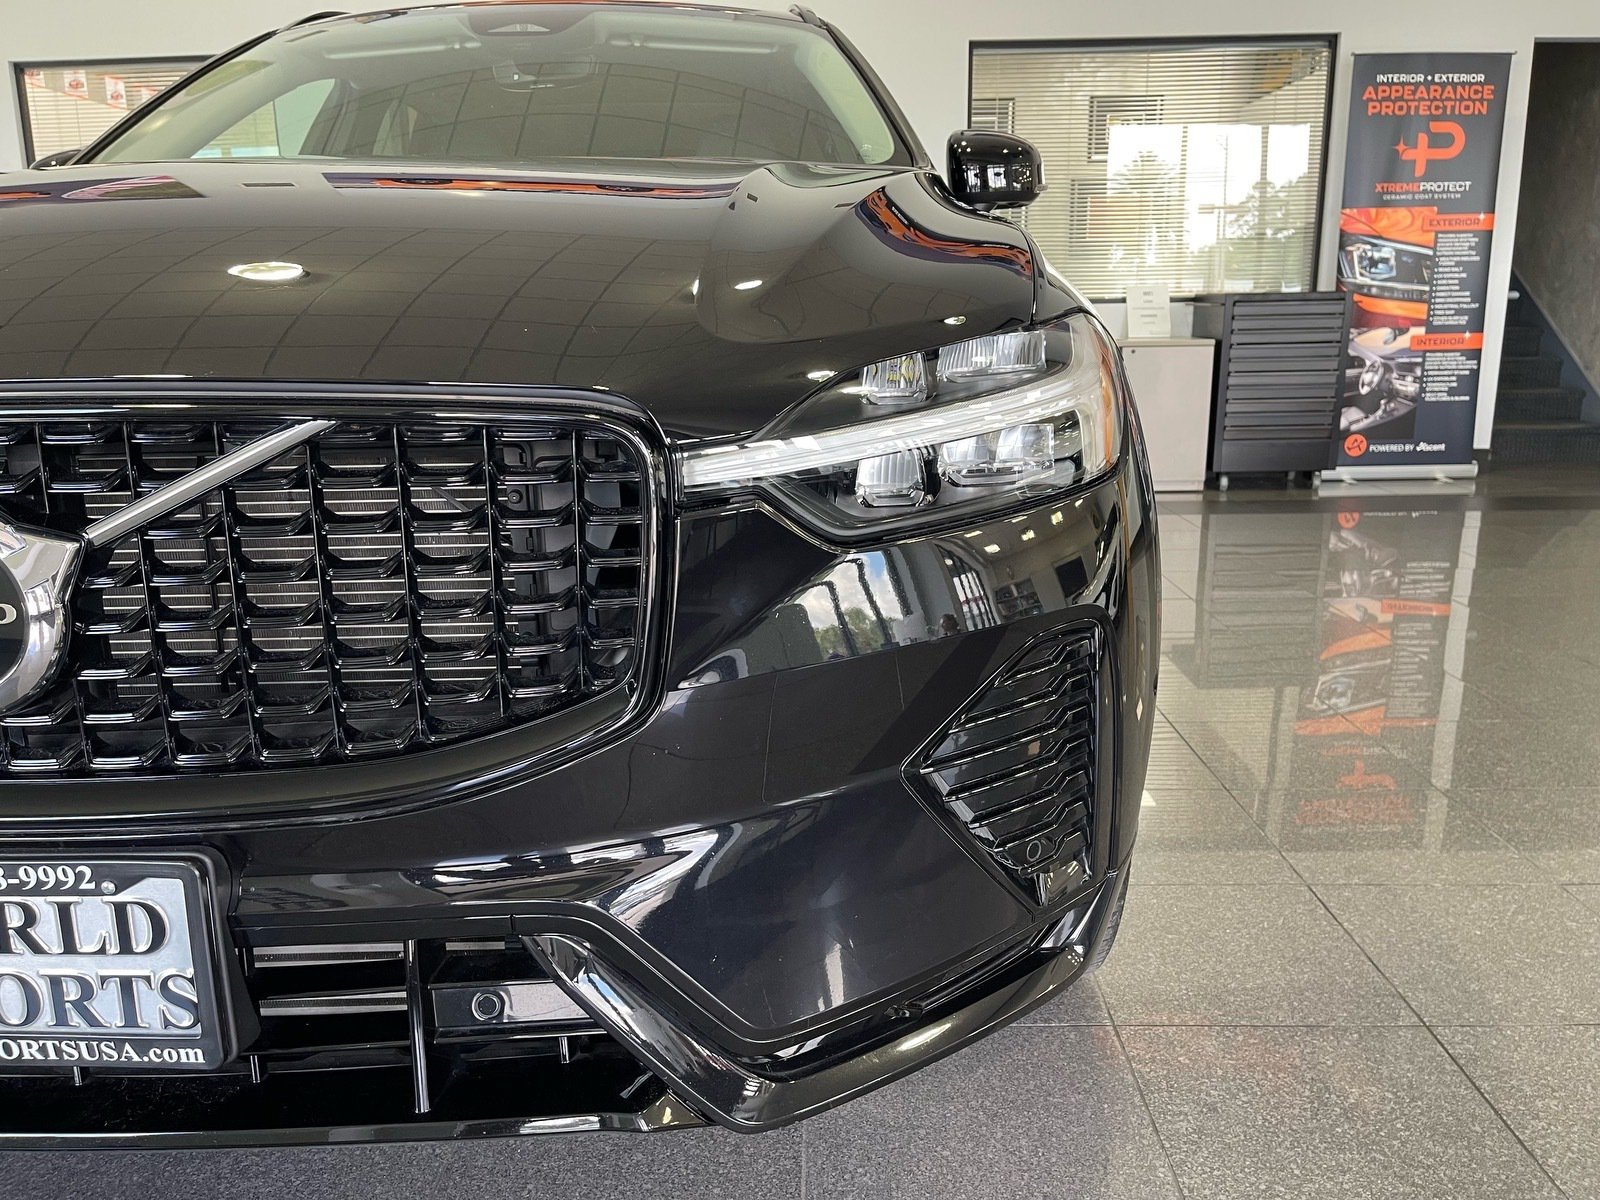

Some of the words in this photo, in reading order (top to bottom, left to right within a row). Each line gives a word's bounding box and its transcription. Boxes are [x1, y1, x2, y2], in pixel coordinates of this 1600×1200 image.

[1376, 74, 1424, 83] INTERIOR
[1434, 73, 1485, 83] EXTERIOR
[1362, 85, 1495, 100] APPEARANCE
[1367, 100, 1488, 116] PROTECTION
[1428, 218, 1481, 227] EXTERIOR
[1416, 336, 1465, 346] INTERIOR
[1369, 443, 1404, 452] POWERED
[1404, 443, 1414, 452] BY
[0, 1038, 206, 1063] ORTSUSA.com
